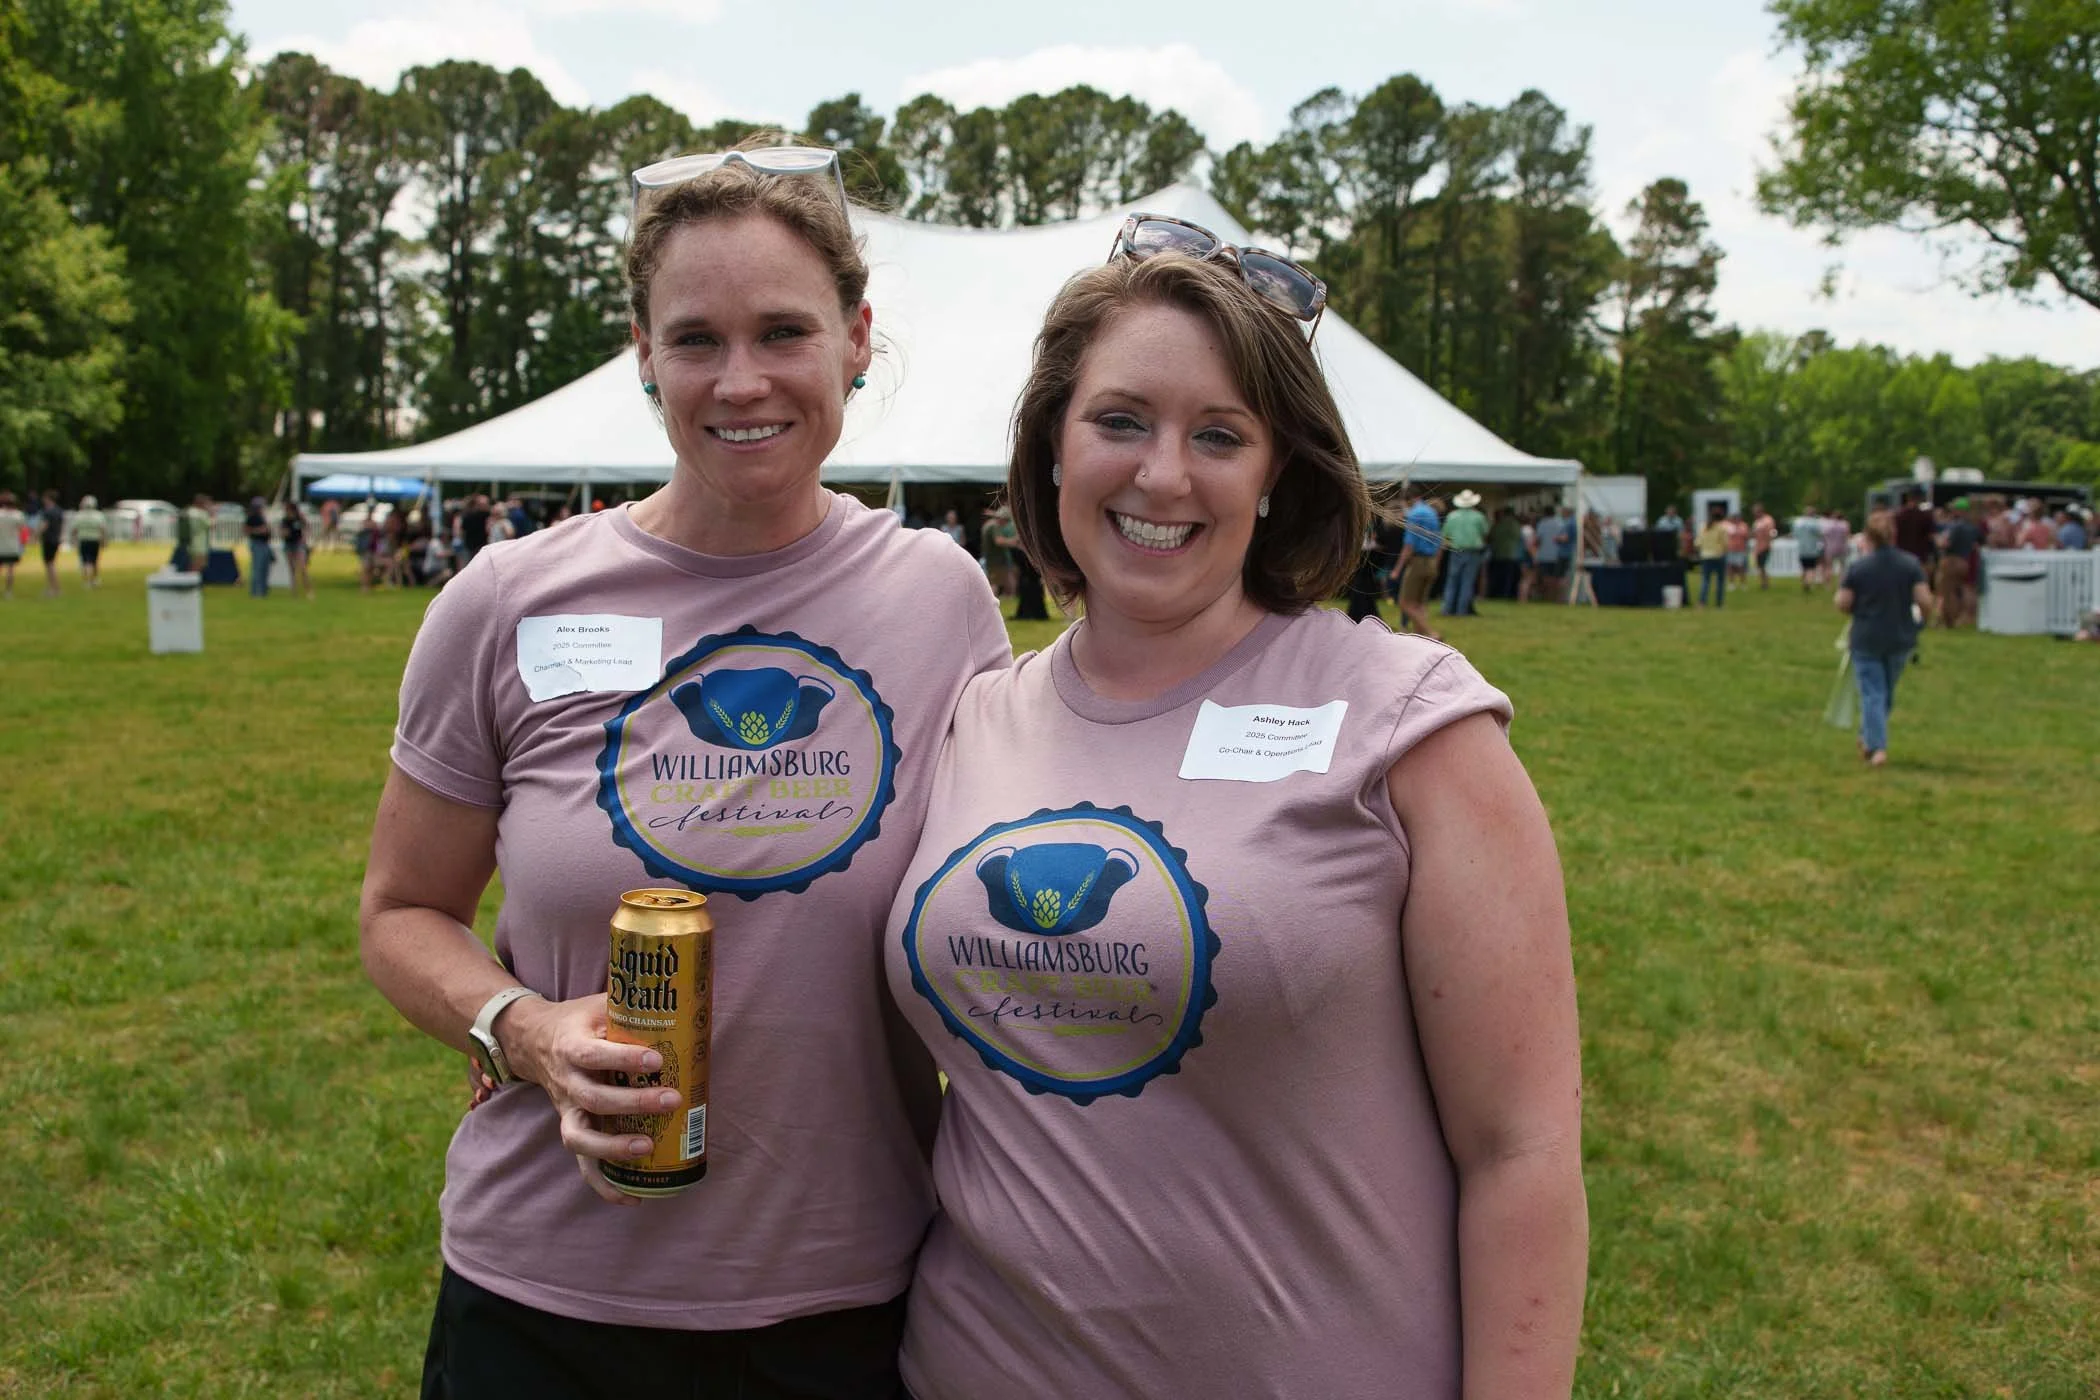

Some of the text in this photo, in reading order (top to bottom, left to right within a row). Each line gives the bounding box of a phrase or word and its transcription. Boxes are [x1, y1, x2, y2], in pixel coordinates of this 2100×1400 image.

[552, 642, 570, 650] 2025
[575, 658, 612, 666] Marketing
[613, 658, 633, 666] Lead
[1252, 715, 1311, 726] Ashley Hack
[1245, 731, 1266, 739] 2025
[1218, 746, 1253, 755] Co-Chair
[652, 749, 850, 781] WILLIAMSBURG
[650, 777, 854, 804] CRAFT BEER
[649, 800, 853, 831] festival
[948, 935, 1149, 976] WILLIAMSBURG
[609, 971, 679, 1013] Death
[968, 996, 1163, 1026] festival
[629, 1016, 677, 1026] CHAINSAW
